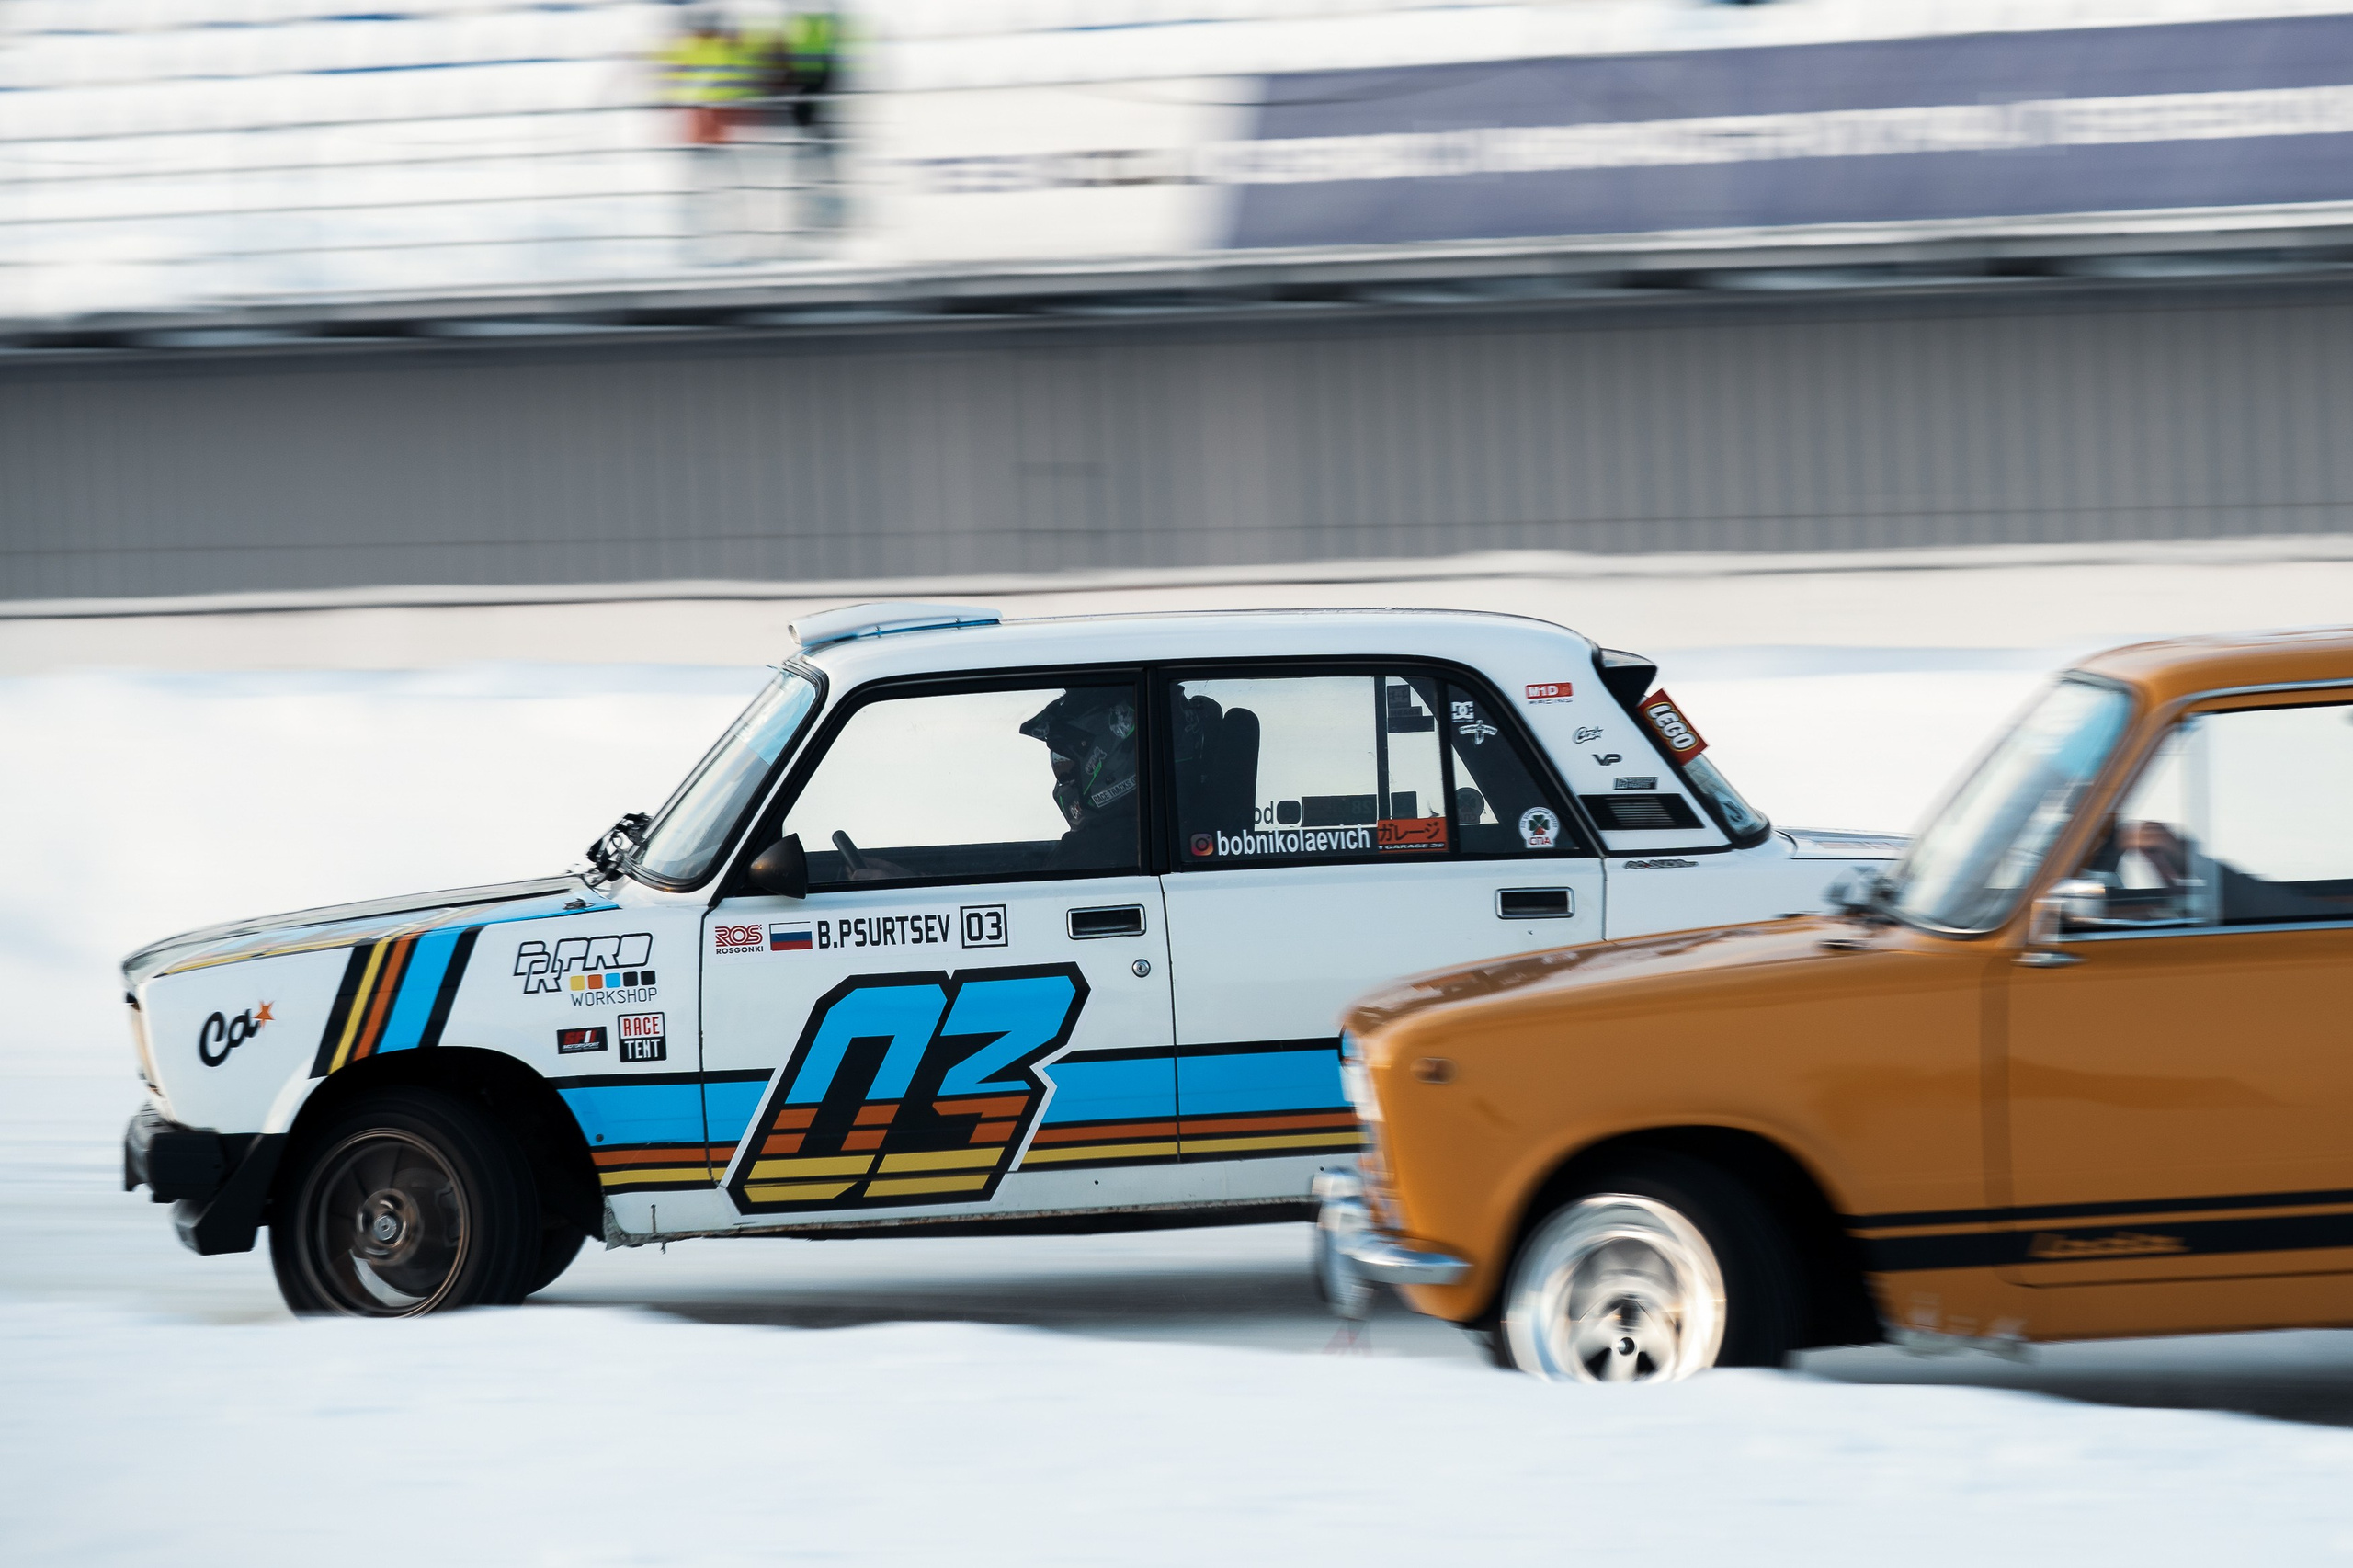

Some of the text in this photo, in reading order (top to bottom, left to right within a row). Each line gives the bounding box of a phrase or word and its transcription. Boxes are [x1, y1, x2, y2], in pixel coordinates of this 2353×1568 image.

[1648, 704, 1696, 750] LEGO
[1094, 791, 1110, 804] RACE
[1109, 780, 1132, 798] TRACKS
[1216, 824, 1370, 856] bobnikolaevich
[1378, 821, 1440, 841] ガレージ
[715, 924, 763, 947] ROS
[817, 914, 950, 949] B.PSURTSEV
[965, 911, 1003, 942] 03
[716, 946, 764, 955] ROSGONKI
[570, 987, 658, 1007] WORKSHOP
[623, 1017, 660, 1037] RACE
